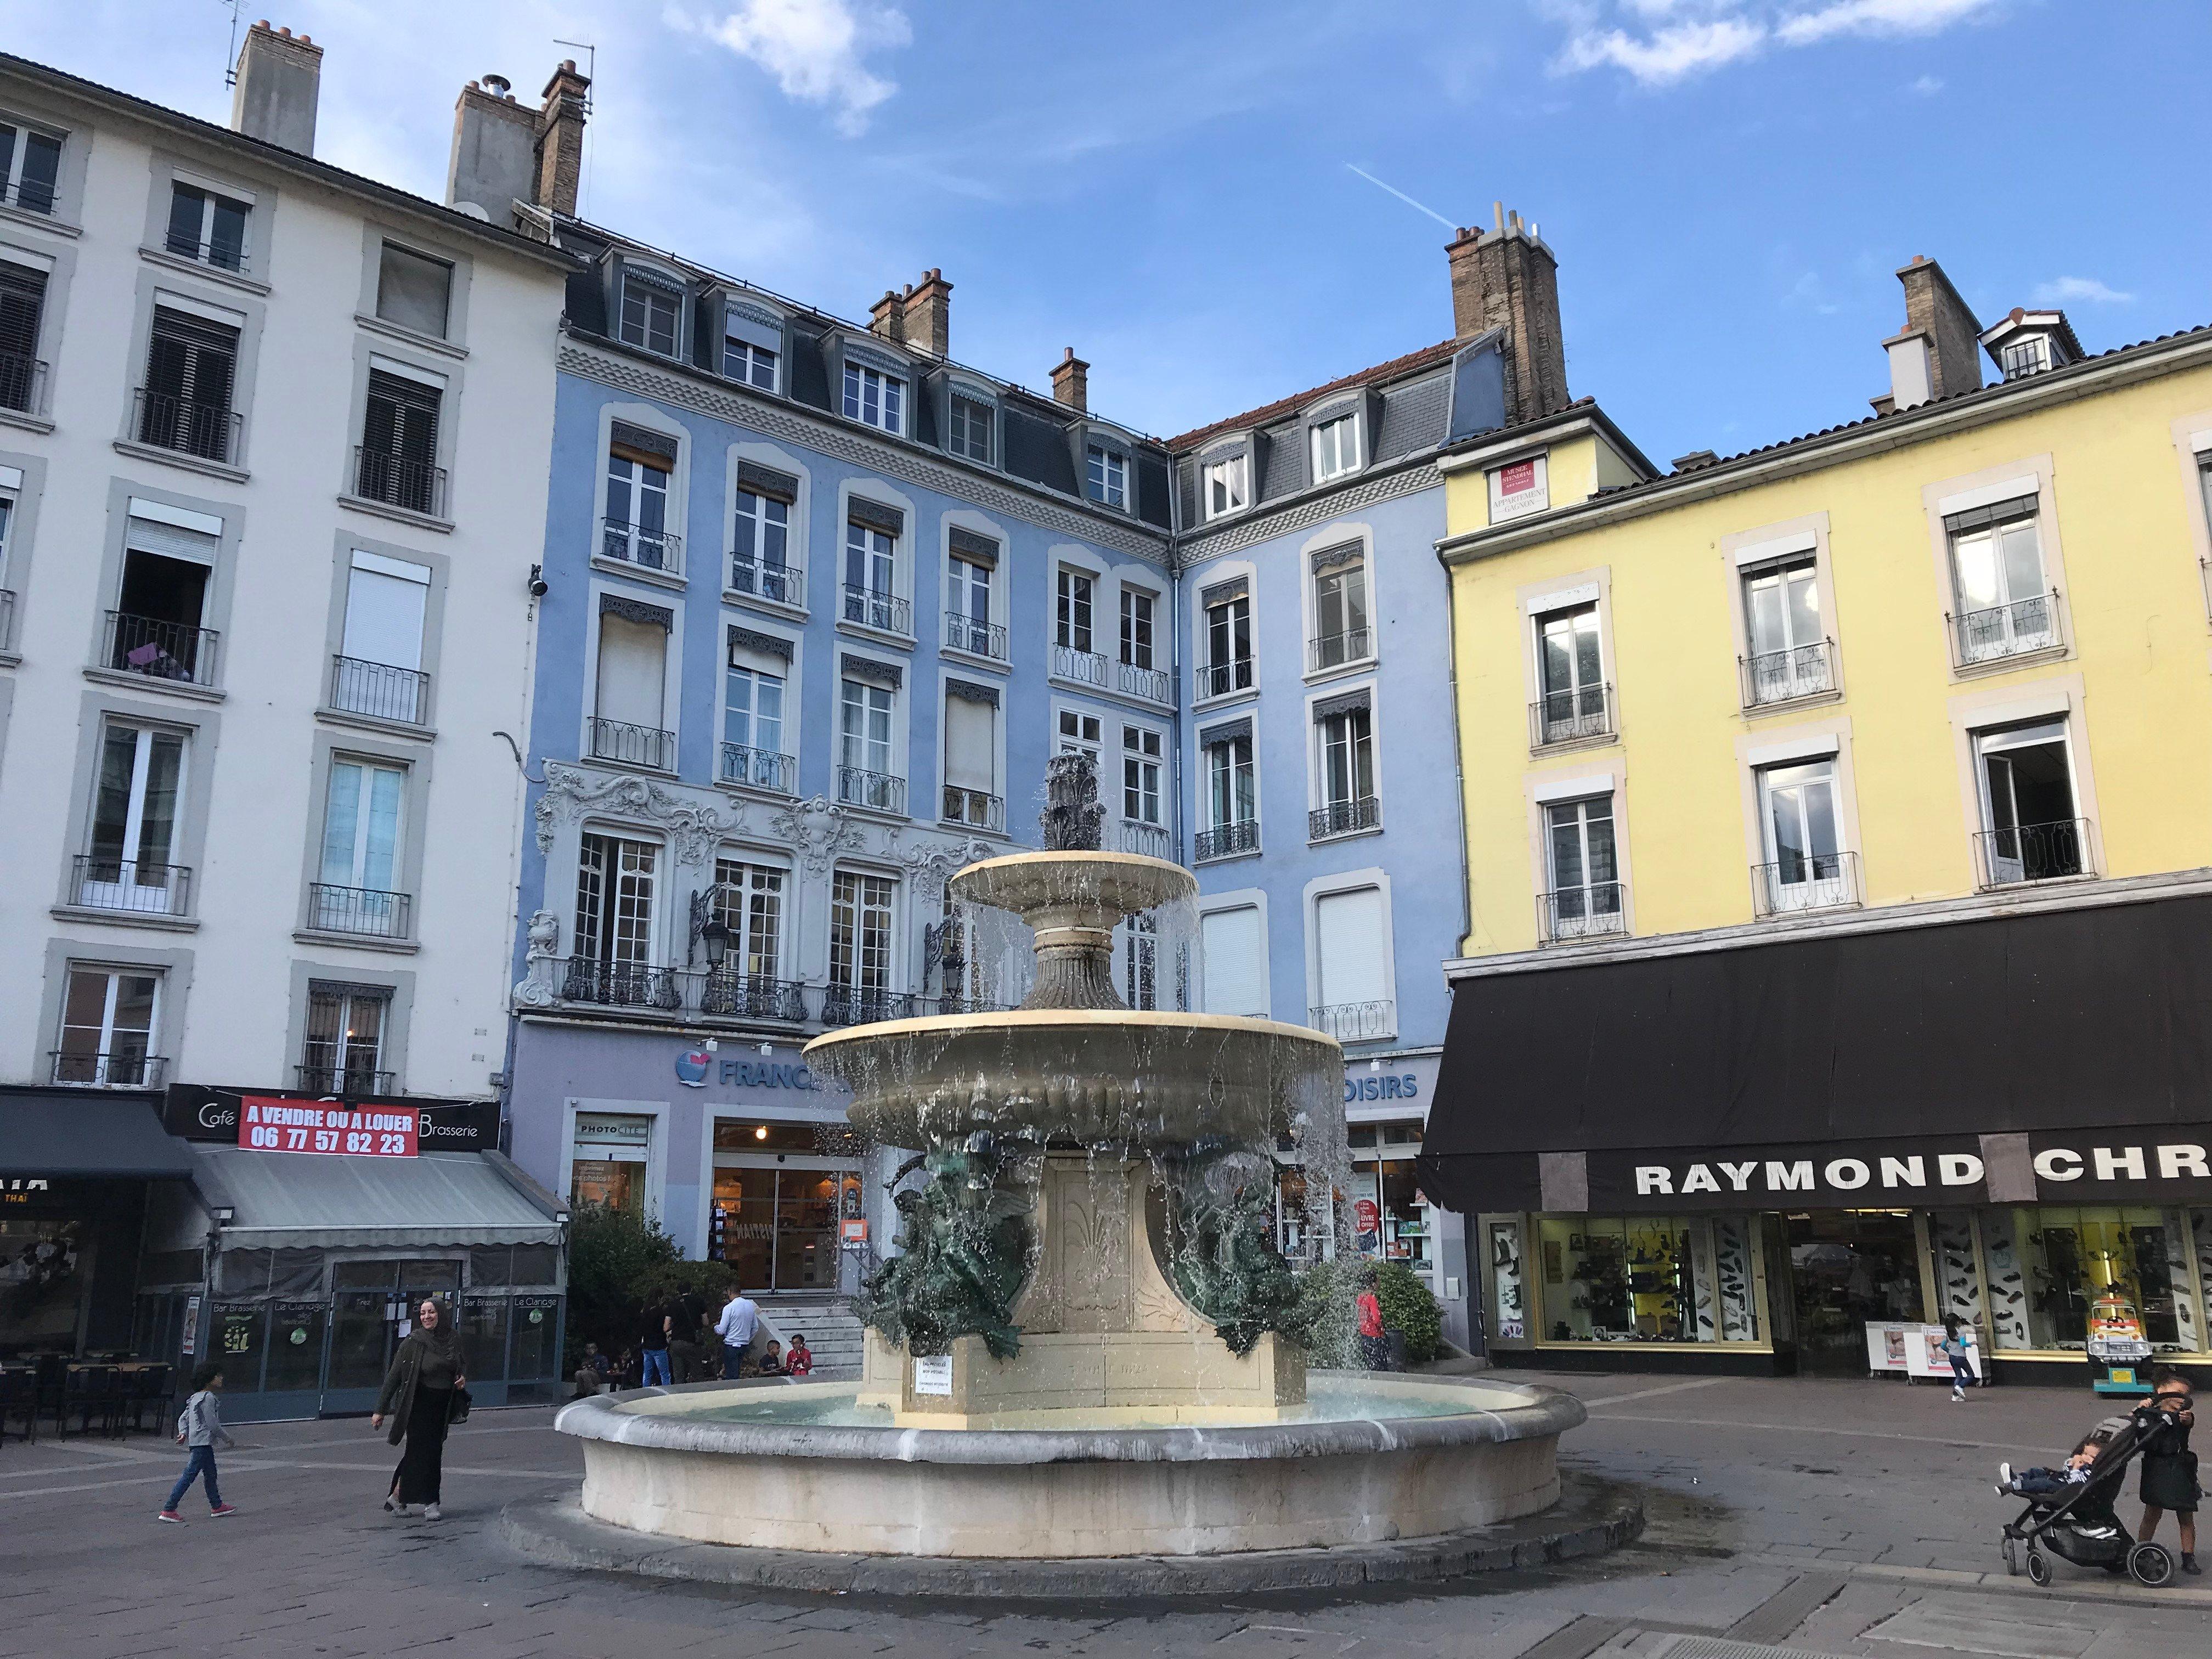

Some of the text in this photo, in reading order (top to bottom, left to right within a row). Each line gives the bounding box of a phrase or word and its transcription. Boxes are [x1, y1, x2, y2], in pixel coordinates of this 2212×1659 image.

[1502, 470, 1533, 483] STENDHAL
[1493, 488, 1546, 508] APPARTEMENT
[1504, 499, 1535, 512] GAGNON
[198, 1103, 235, 1128] Café
[247, 1105, 413, 1132] A VENDRE OU A LOUER
[419, 1114, 478, 1137] Brasserie
[251, 1126, 405, 1154] 06 77 57 82 23
[1635, 1144, 2212, 1195] RAYMOND CHR
[213, 1304, 227, 1312] Bar
[515, 1297, 524, 1306] Le
